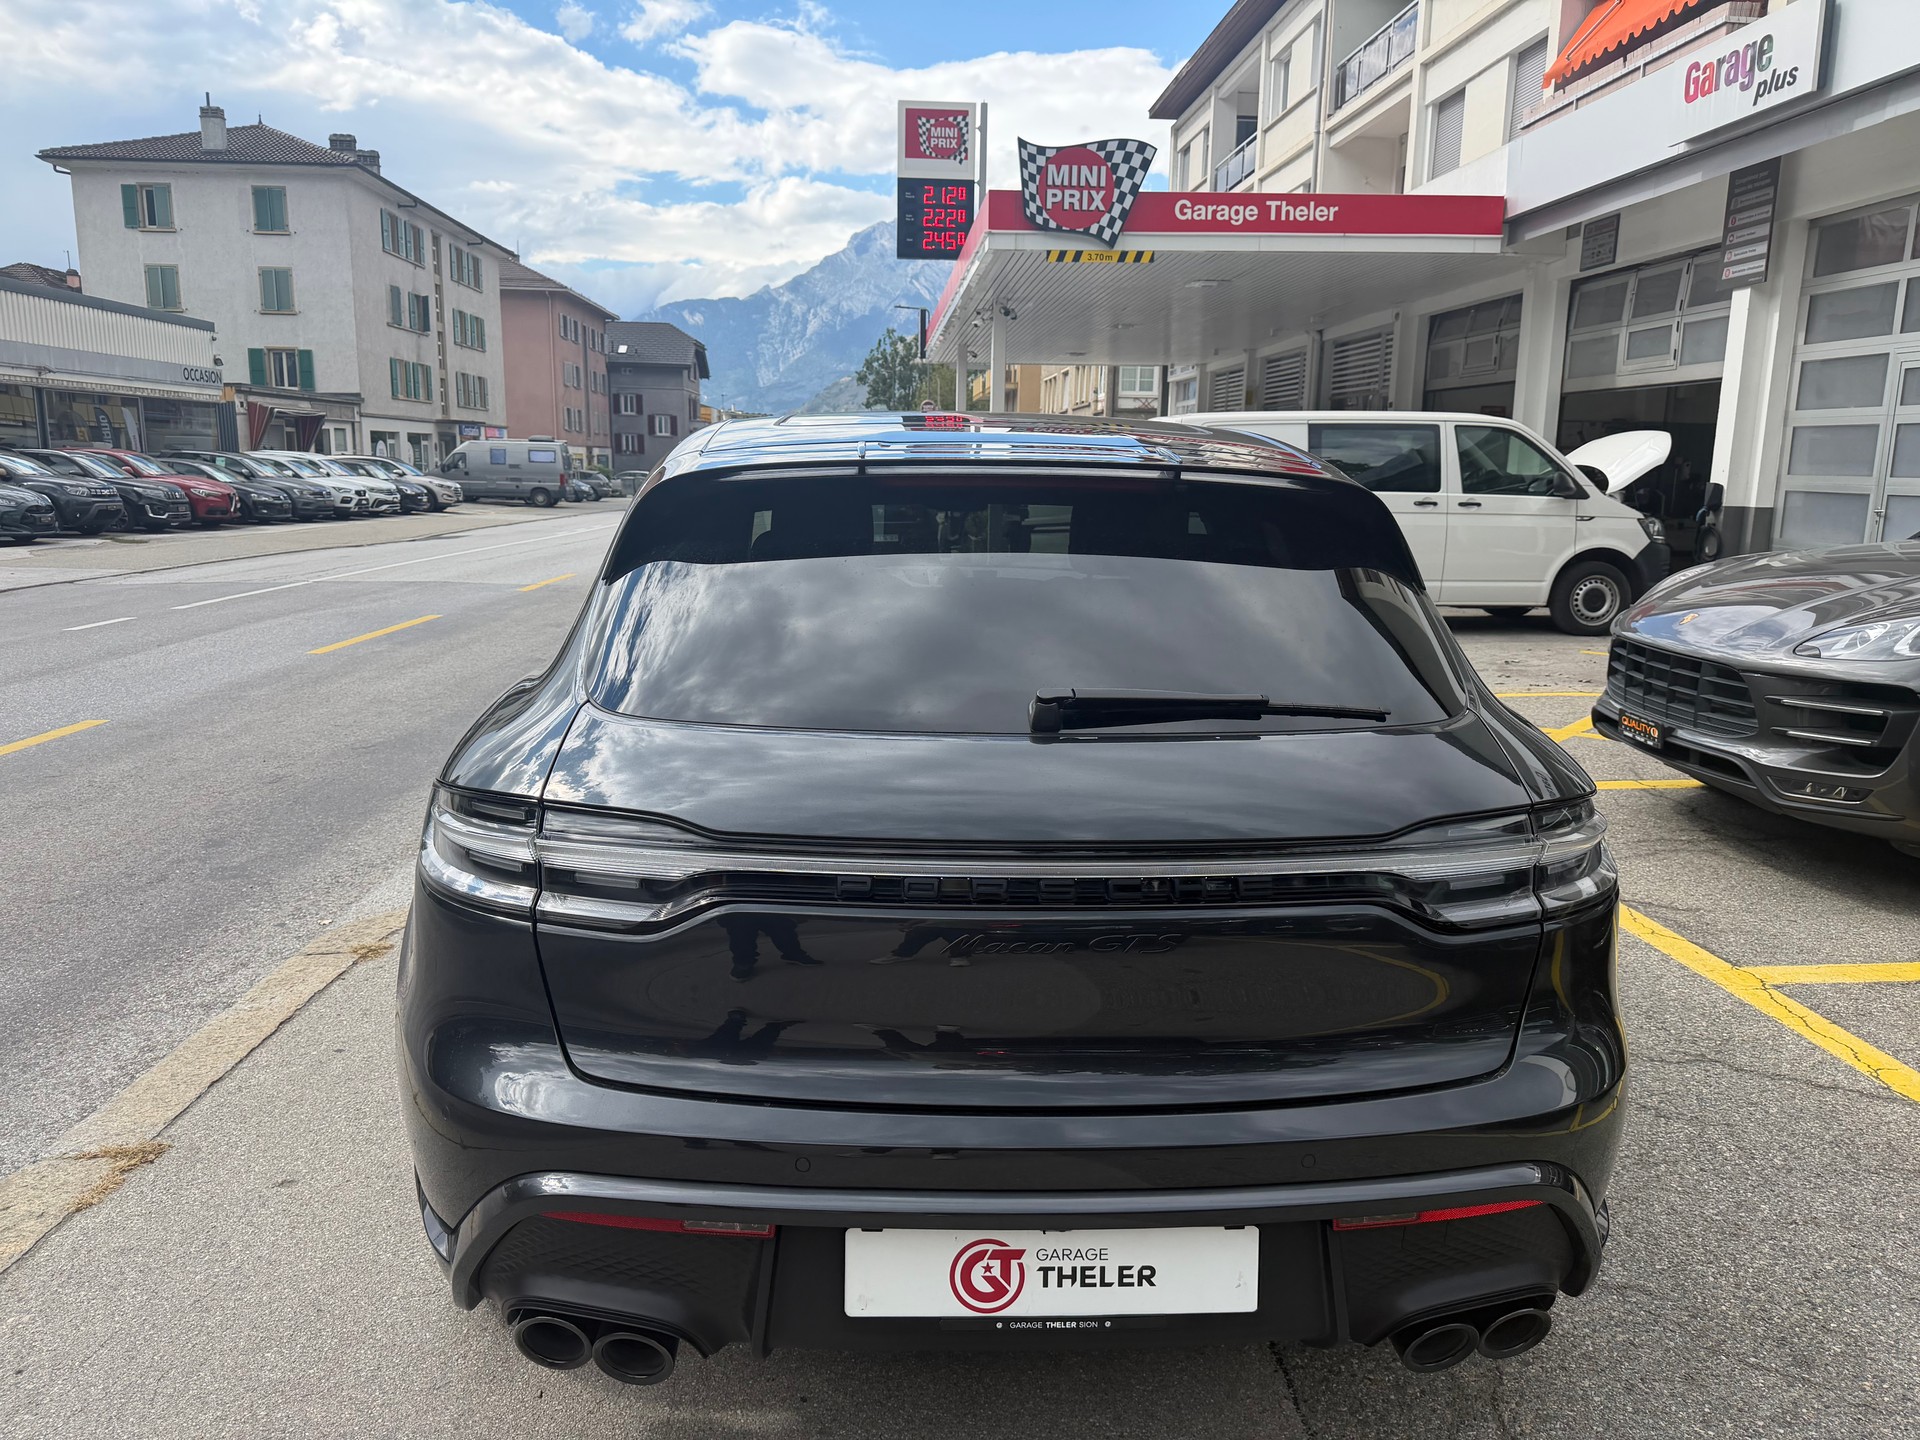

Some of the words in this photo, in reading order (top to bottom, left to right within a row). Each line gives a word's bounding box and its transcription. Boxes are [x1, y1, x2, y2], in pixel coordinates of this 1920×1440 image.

[1684, 33, 1774, 104] Garage
[1752, 66, 1799, 106] plus
[930, 127, 958, 138] MINI
[930, 138, 958, 149] PRIX
[1045, 163, 1107, 188] MINI
[1045, 187, 1106, 212] PRIX
[1174, 199, 1259, 228] Garage
[1266, 199, 1339, 223] Theler
[183, 367, 222, 384] OCCASION
[836, 875, 1273, 902] PORSCHE
[938, 933, 1073, 955] Macan
[1088, 933, 1182, 955] GTS
[1036, 1248, 1109, 1261] GARAGE
[1036, 1265, 1157, 1288] THELER
[1009, 1321, 1043, 1329] GARAGE
[1045, 1321, 1077, 1329] THELER
[1078, 1321, 1099, 1329] SION
